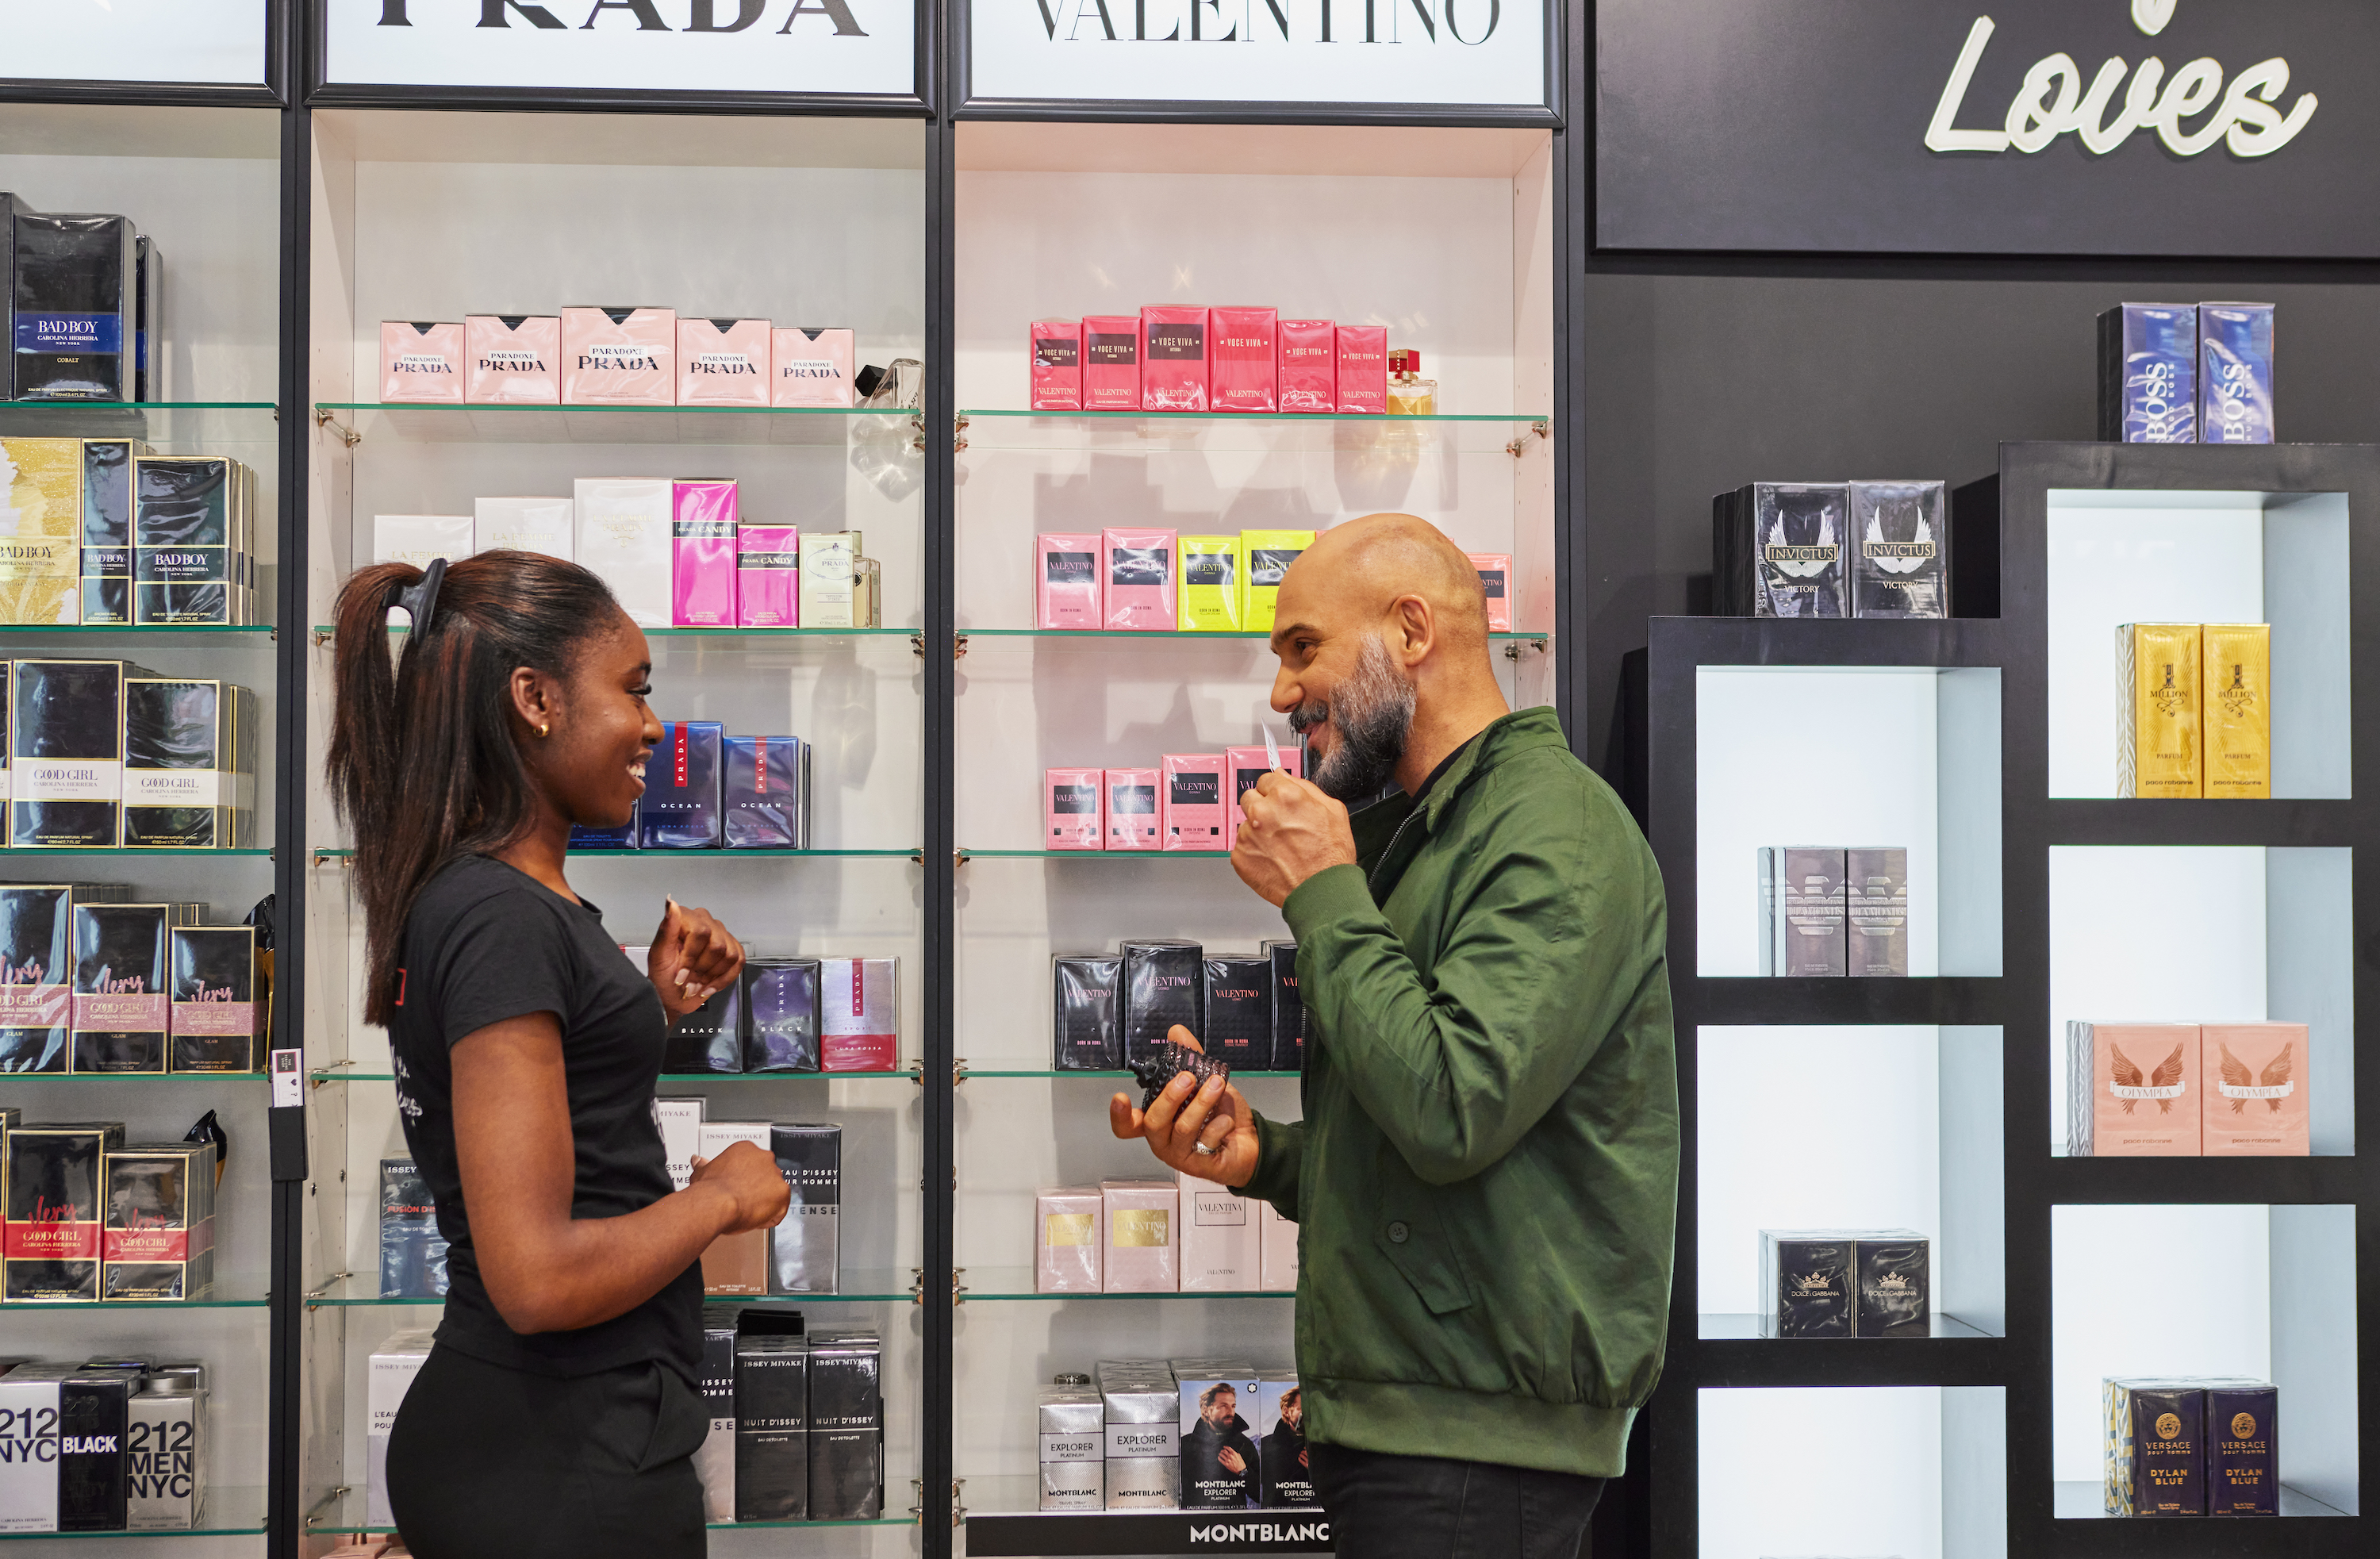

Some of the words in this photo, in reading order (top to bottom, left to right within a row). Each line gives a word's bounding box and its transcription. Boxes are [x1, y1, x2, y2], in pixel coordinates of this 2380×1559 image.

[1925, 15, 2318, 157] Loves
[38, 321, 67, 333] BAD
[69, 321, 98, 333] BOY
[1177, 338, 1192, 347] VIVA
[393, 363, 452, 374] PRADA
[479, 360, 547, 372] PRADA
[578, 356, 659, 371] PRADA
[691, 363, 757, 374] PRADA
[784, 367, 841, 378] PRADA
[2146, 362, 2167, 440] BOSS
[2223, 363, 2245, 441] BOSS
[0, 547, 23, 558] BAD
[27, 547, 55, 558] BOY
[1771, 548, 1833, 559] INVICTUS
[1868, 545, 1931, 556] INVICTUS
[155, 555, 181, 565] BAD
[182, 555, 209, 565] BOY
[1050, 562, 1092, 570] VALENTINO
[33, 769, 65, 781] GOOD
[67, 769, 98, 781] GIRL
[141, 778, 169, 788] GOOD
[171, 778, 199, 788] GIRL
[1174, 782, 1217, 791] VALENTINO
[96, 968, 144, 995] Very
[1138, 977, 1191, 986] VALENTINO
[191, 980, 233, 1004] Very
[1215, 989, 1258, 998] VALENTINO
[29, 1196, 77, 1229] Very
[1199, 1204, 1242, 1212] VALENTINA
[125, 1208, 167, 1237] Very
[1116, 1222, 1166, 1231] VALENTINO
[23, 1231, 52, 1241] GOOD
[53, 1231, 82, 1241] GIRL
[121, 1238, 144, 1247] GOOD
[146, 1238, 170, 1247] GIRL
[0, 1408, 58, 1439] 212
[842, 1416, 873, 1425] D'ISSEY
[129, 1421, 192, 1452] 212
[1117, 1435, 1167, 1445] EXPLORER
[63, 1435, 117, 1453] BLACK
[1050, 1443, 1093, 1452] EXPLORER
[0, 1440, 57, 1462] NYC
[129, 1453, 191, 1474] MEN
[128, 1475, 191, 1498] NYC
[1190, 1523, 1330, 1543] MONTBLANC
